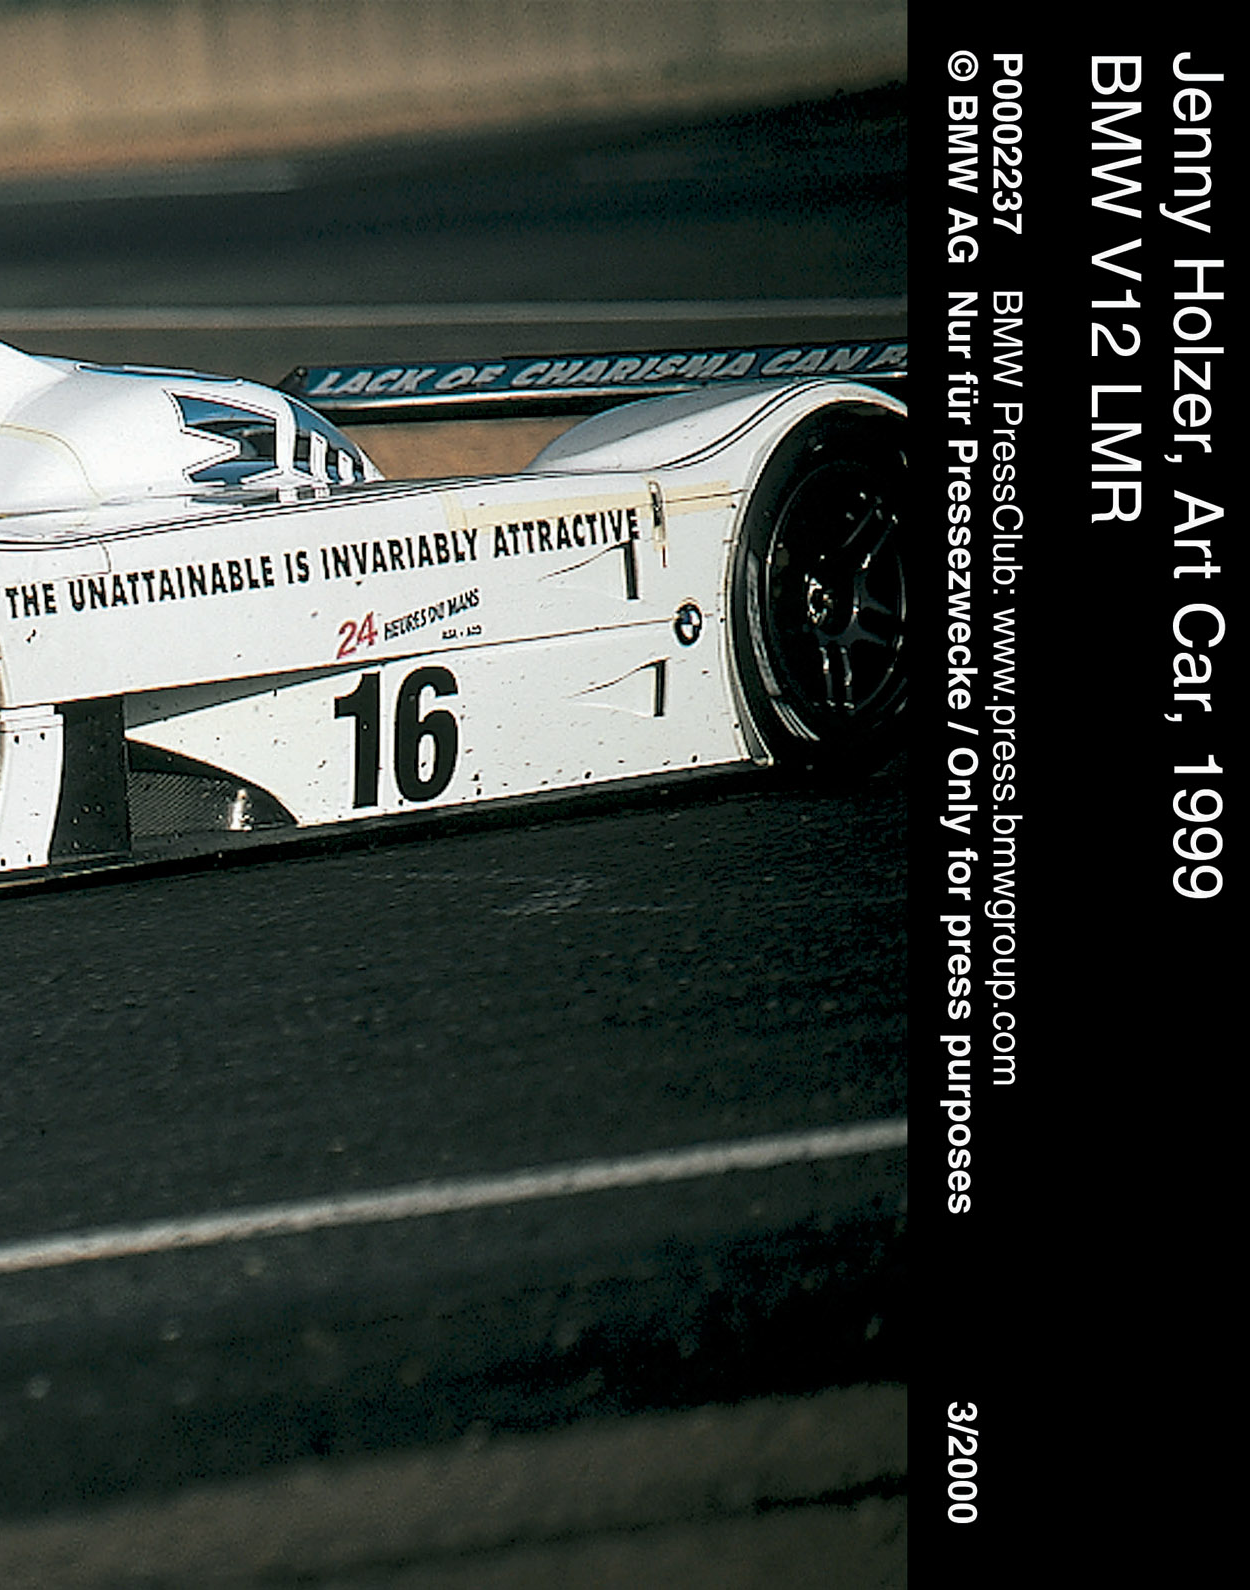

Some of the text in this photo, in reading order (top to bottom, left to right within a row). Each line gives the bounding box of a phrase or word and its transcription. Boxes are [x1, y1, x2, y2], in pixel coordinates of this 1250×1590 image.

[308, 368, 436, 395] LACK
[434, 364, 507, 390] OF
[511, 352, 756, 387] CHARISMA
[760, 349, 870, 375] CAN
[5, 507, 639, 620] THE UNATTAINABLE IS INVARIABLY ATTRACTIVE
[336, 611, 378, 660] 24
[333, 665, 460, 810] 16
